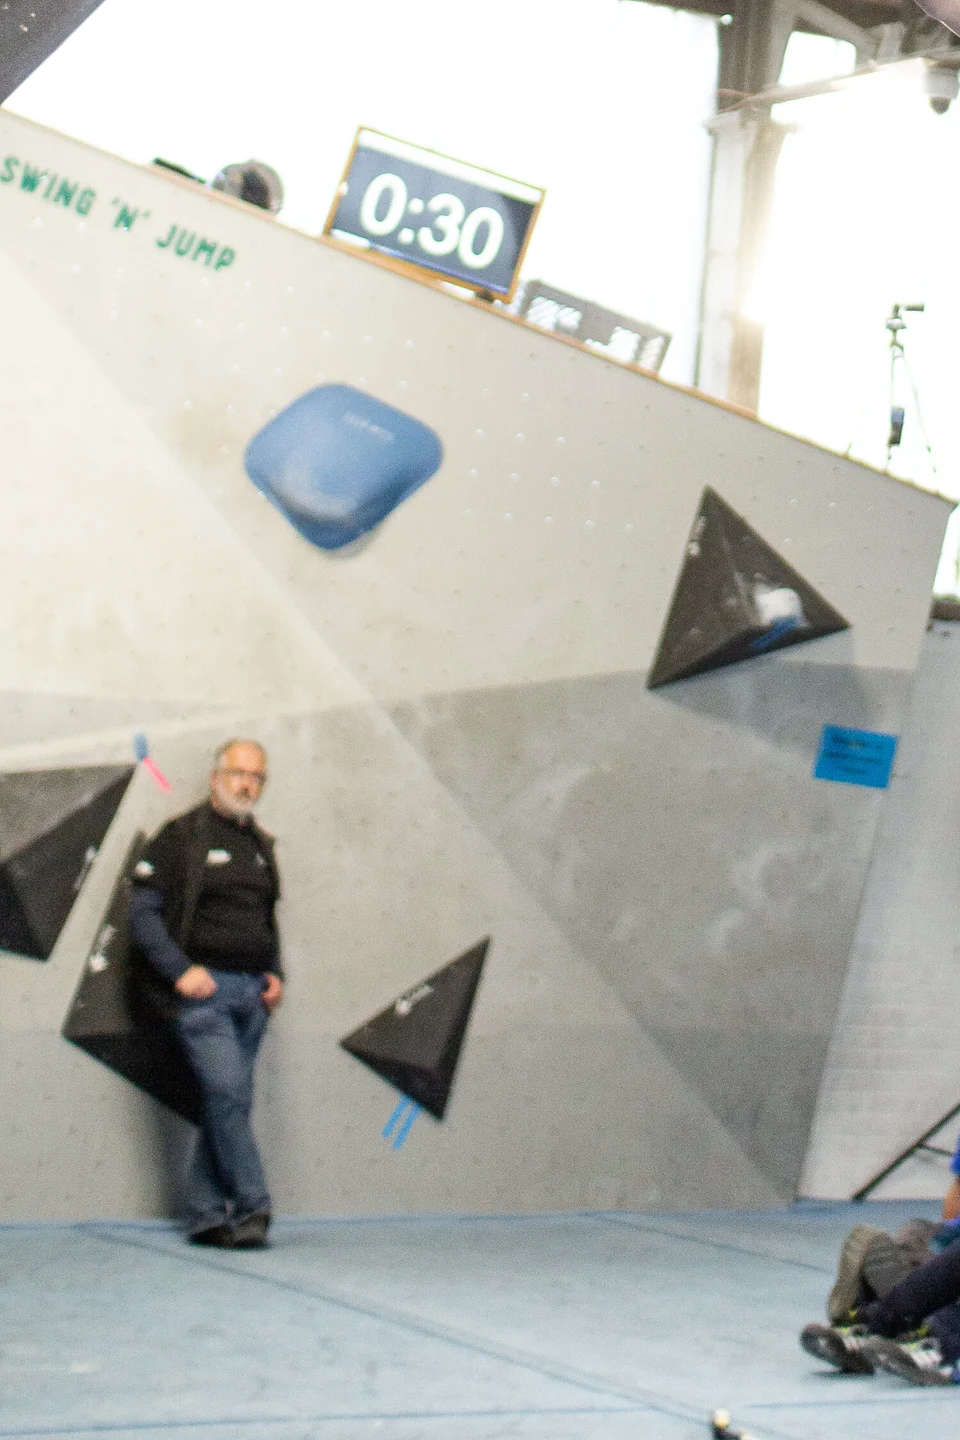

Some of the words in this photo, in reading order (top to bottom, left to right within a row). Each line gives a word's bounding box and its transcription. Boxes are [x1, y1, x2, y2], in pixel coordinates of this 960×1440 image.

[0, 155, 96, 216] SWING
[155, 223, 236, 271] JUMP
[359, 172, 505, 270] 0:30
